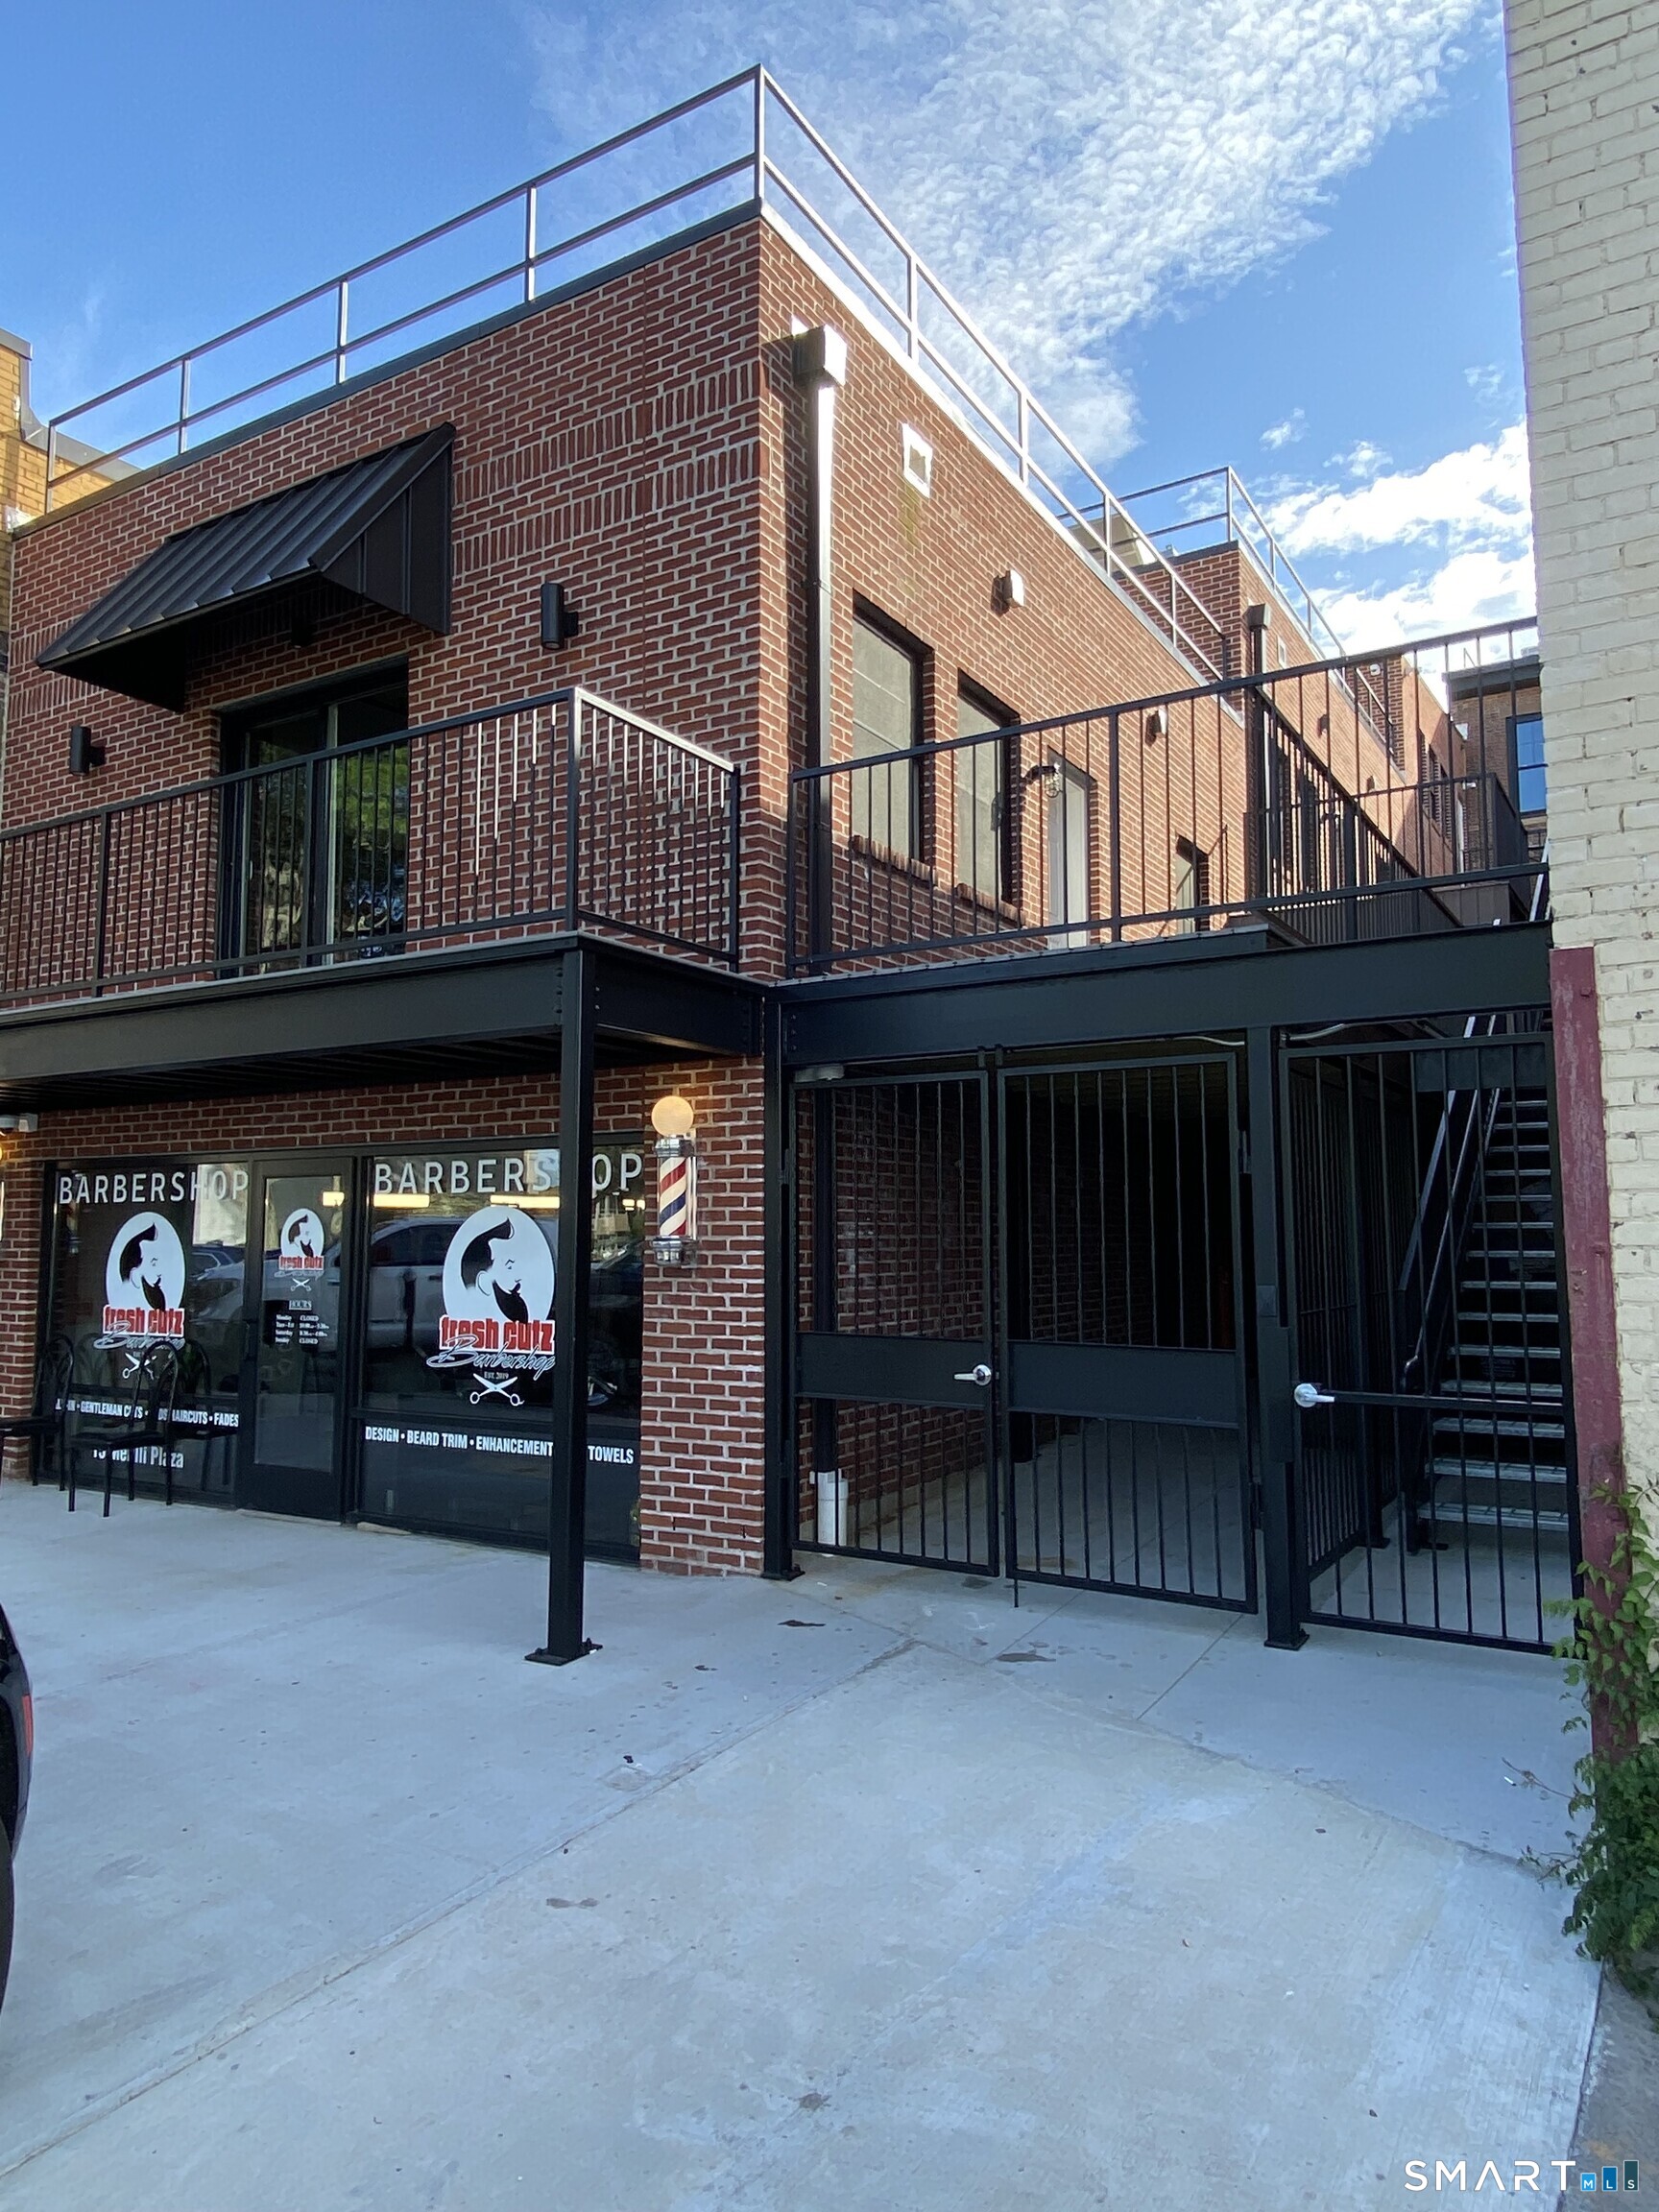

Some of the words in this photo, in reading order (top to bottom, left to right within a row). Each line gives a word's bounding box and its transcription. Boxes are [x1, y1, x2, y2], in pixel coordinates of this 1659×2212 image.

[60, 1170, 249, 1204] BARBERSHOP
[374, 1153, 643, 1194] BARBERSOP
[442, 1317, 499, 1349] fresh
[504, 1320, 553, 1352] cutz
[426, 1334, 556, 1381] Barbershop
[80, 1401, 123, 1417] GENTLEMAN
[213, 1412, 239, 1428] FADES
[365, 1426, 399, 1443] DESIGN
[406, 1430, 440, 1447] BEARD
[442, 1432, 468, 1450] TRIM
[476, 1436, 553, 1457] ENHANCEMENT
[588, 1445, 635, 1464] TOWELS
